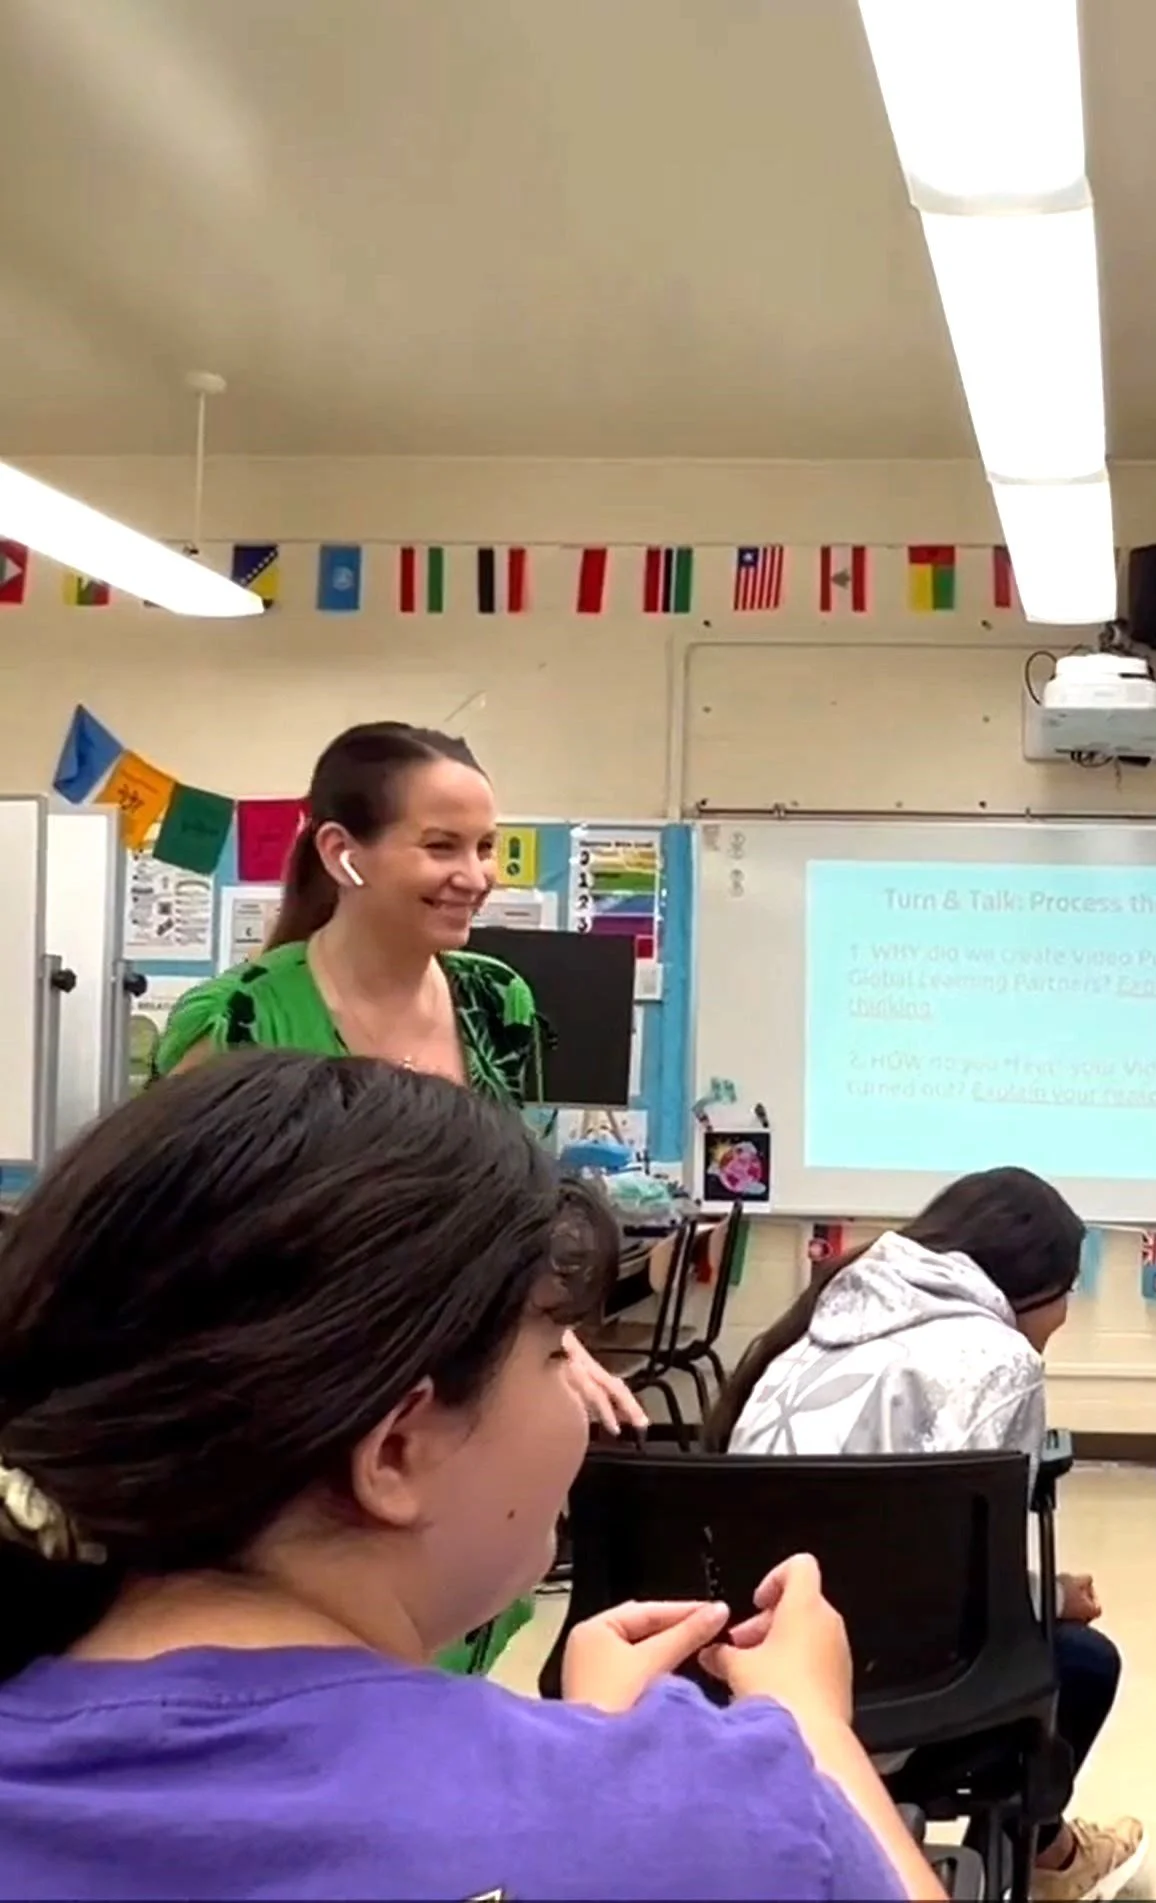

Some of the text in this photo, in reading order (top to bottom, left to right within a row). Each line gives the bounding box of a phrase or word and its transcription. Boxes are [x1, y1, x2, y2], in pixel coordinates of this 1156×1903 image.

[578, 872, 588, 888] 1
[578, 894, 589, 908] 2
[884, 888, 937, 911] Turn
[942, 889, 961, 911] &
[969, 889, 1024, 912] Talk:
[1030, 890, 1123, 913] Process
[871, 943, 920, 960] WHY
